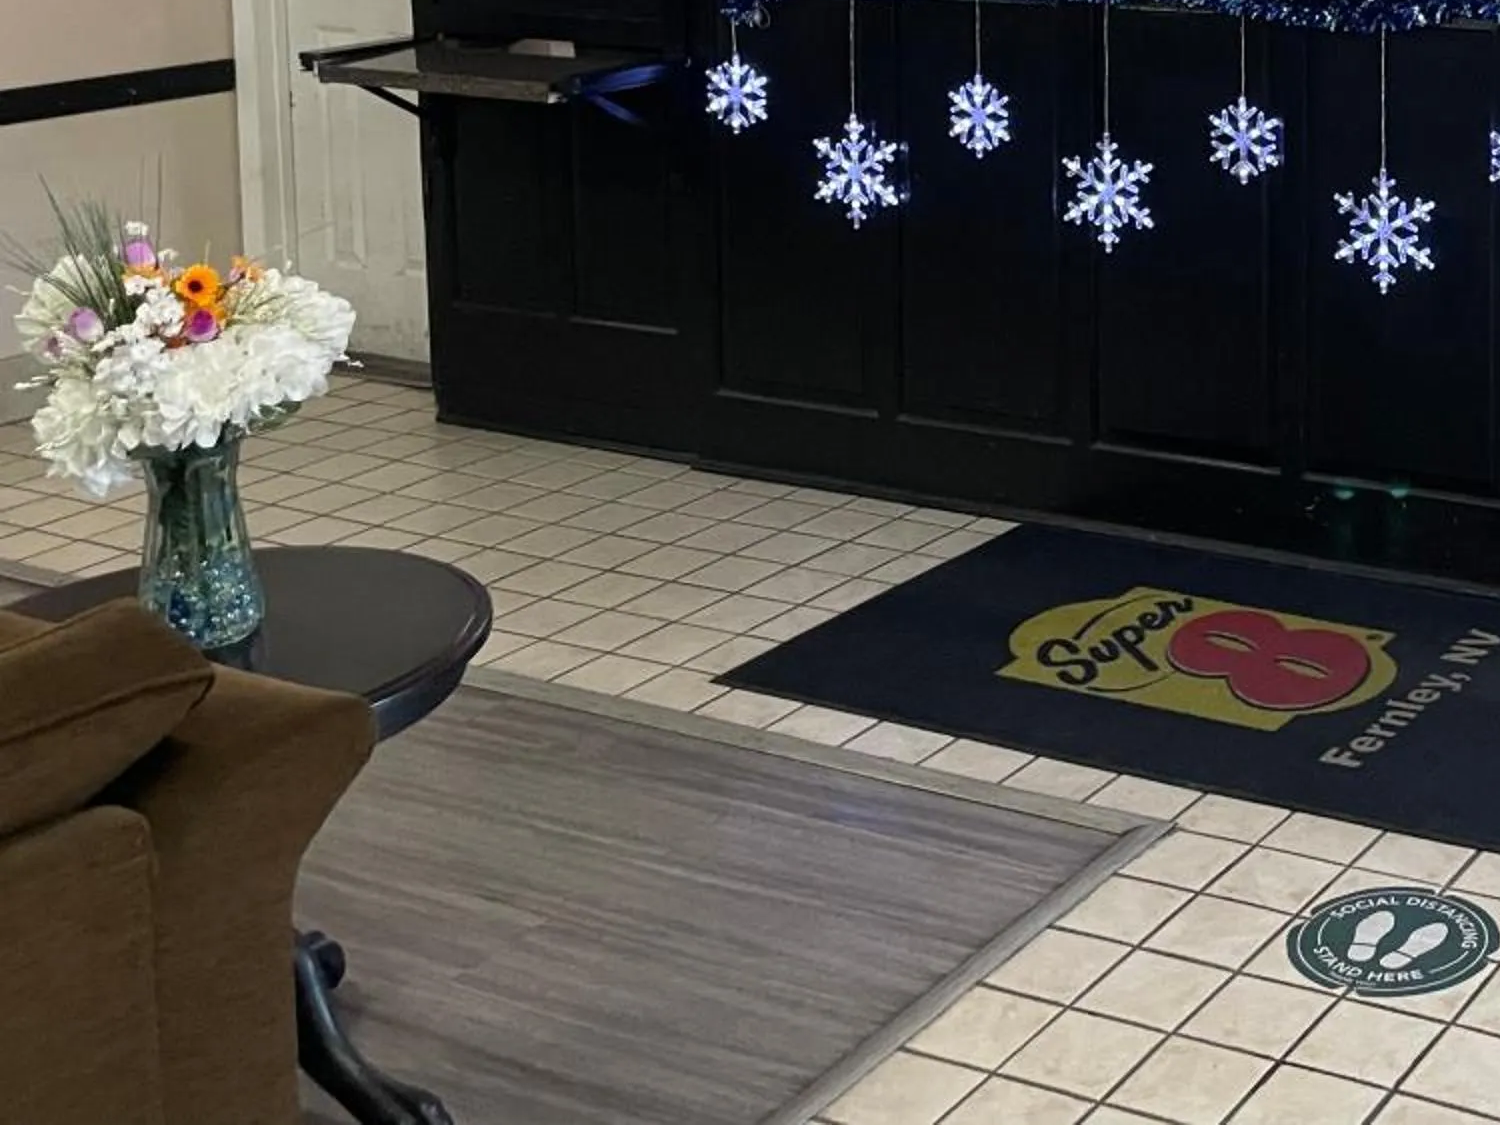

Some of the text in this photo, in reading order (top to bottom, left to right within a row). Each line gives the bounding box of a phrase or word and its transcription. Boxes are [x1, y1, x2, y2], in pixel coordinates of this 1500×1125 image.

[1036, 596, 1373, 711] Super 8
[1319, 668, 1473, 768] Fernley,
[1330, 896, 1480, 950] SOCIAL DISTANCING
[1313, 945, 1362, 978] STAND
[1367, 969, 1424, 983] HERE
